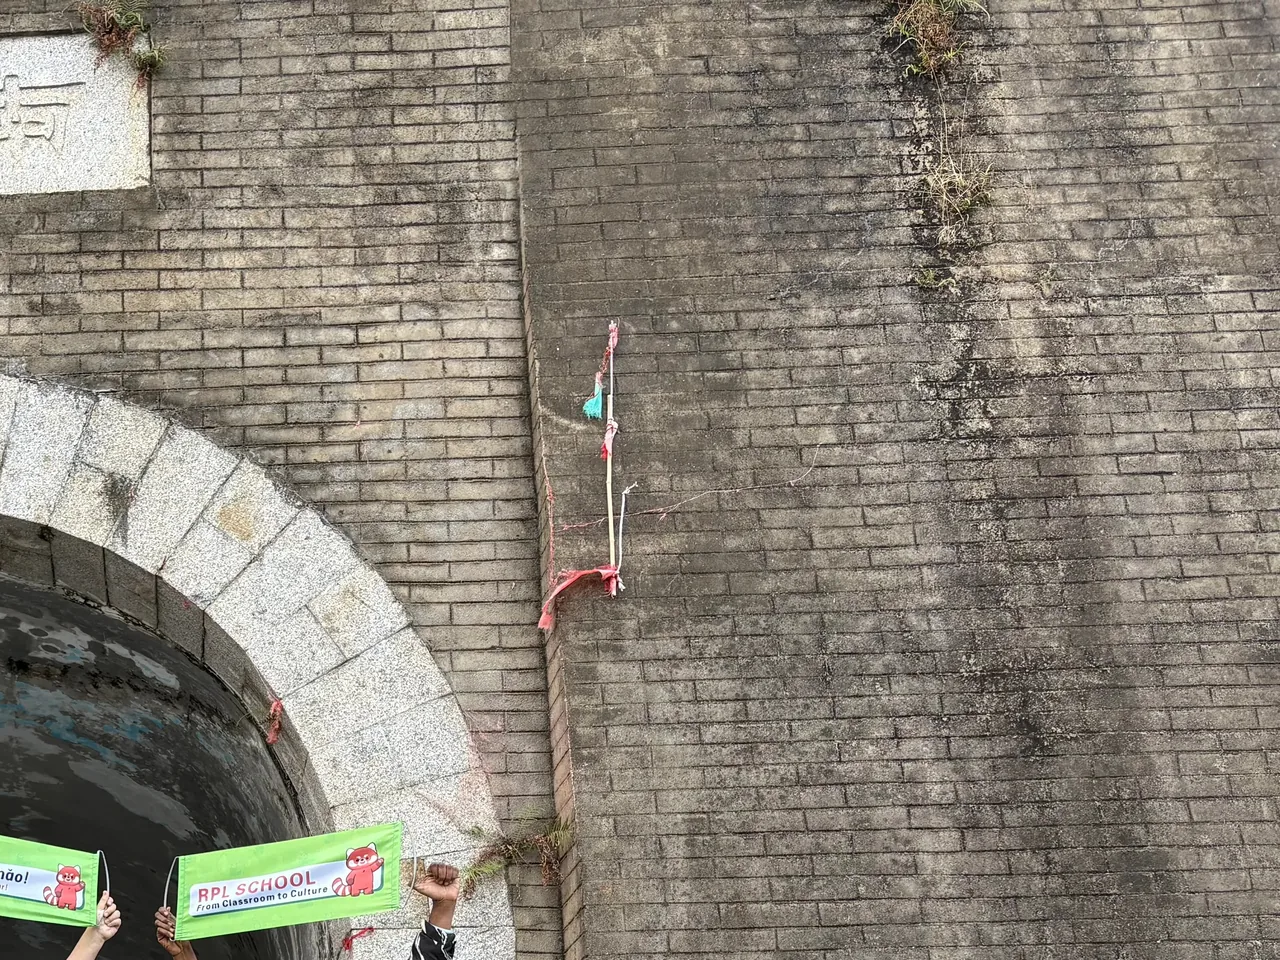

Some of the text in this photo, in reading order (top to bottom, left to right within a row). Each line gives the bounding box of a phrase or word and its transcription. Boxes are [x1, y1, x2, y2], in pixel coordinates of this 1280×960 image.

[196, 886, 328, 912] From Classroom to Culture
[198, 870, 316, 903] RPL SCHOOL
